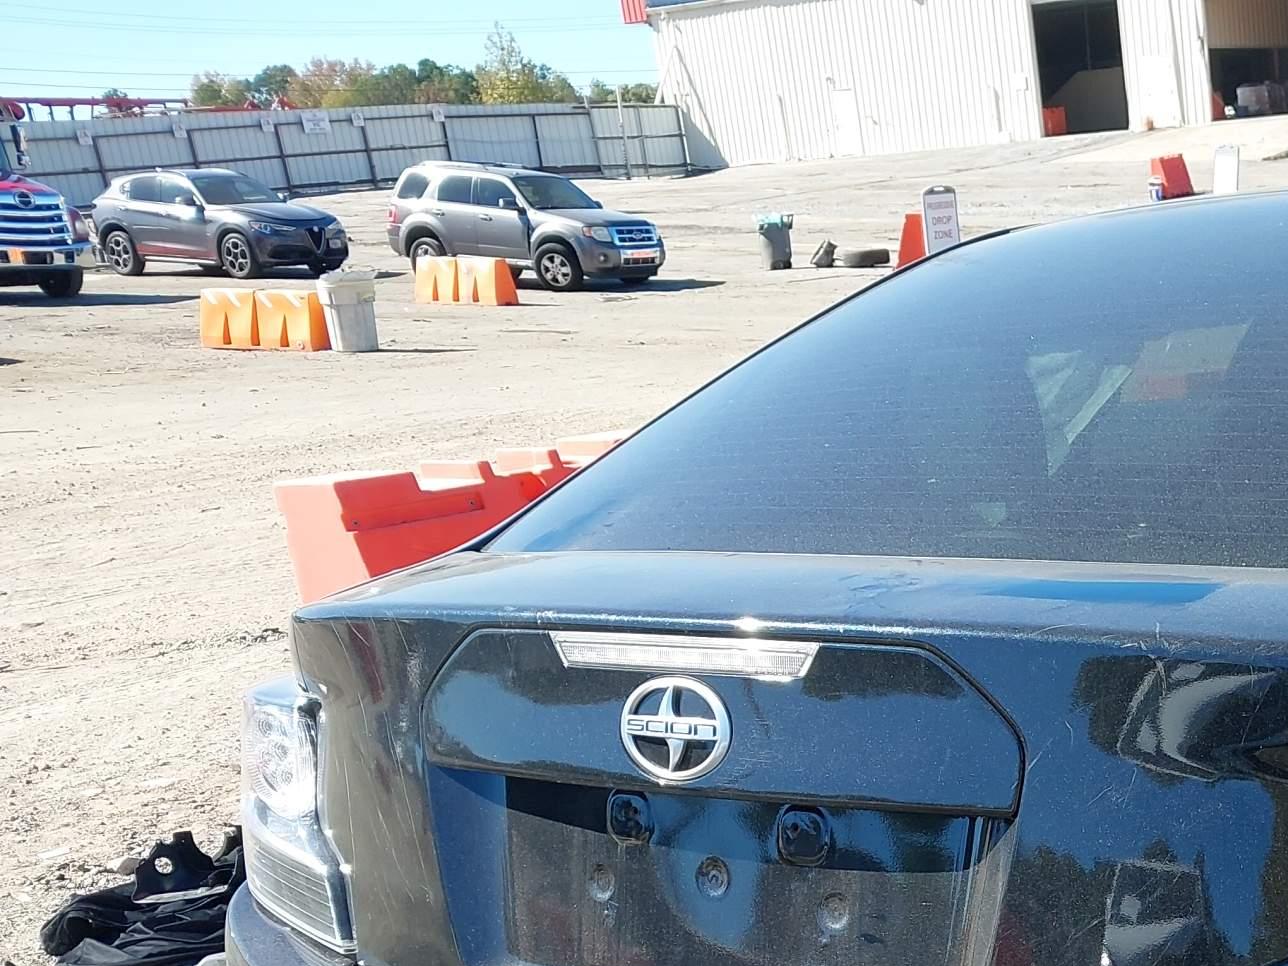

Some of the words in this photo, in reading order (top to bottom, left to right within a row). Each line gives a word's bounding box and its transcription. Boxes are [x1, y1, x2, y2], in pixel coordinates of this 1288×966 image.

[931, 215, 952, 225] DROP
[933, 229, 953, 240] ZONE
[626, 718, 717, 738] SCION
